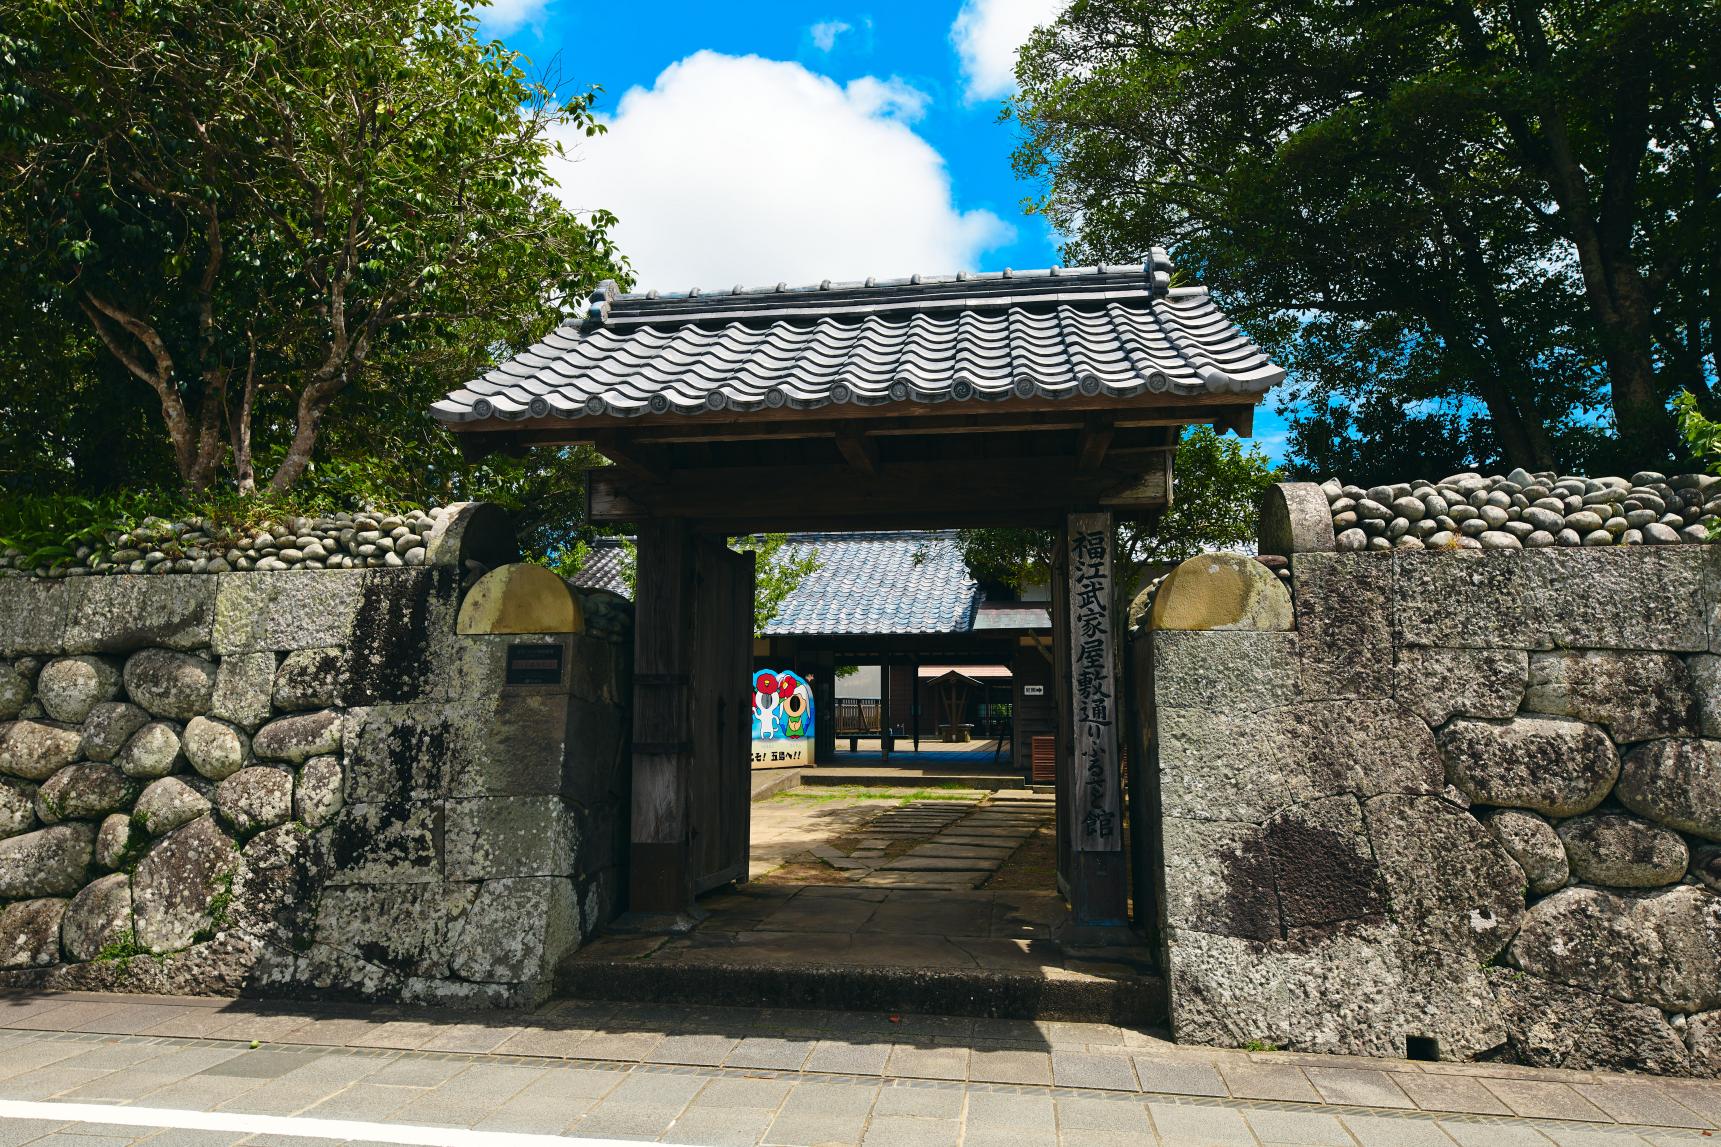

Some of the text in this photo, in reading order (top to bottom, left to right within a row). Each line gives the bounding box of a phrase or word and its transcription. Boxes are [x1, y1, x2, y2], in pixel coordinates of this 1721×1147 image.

[1072, 530, 1114, 838] 福江武家屋敷通りふるさと館
